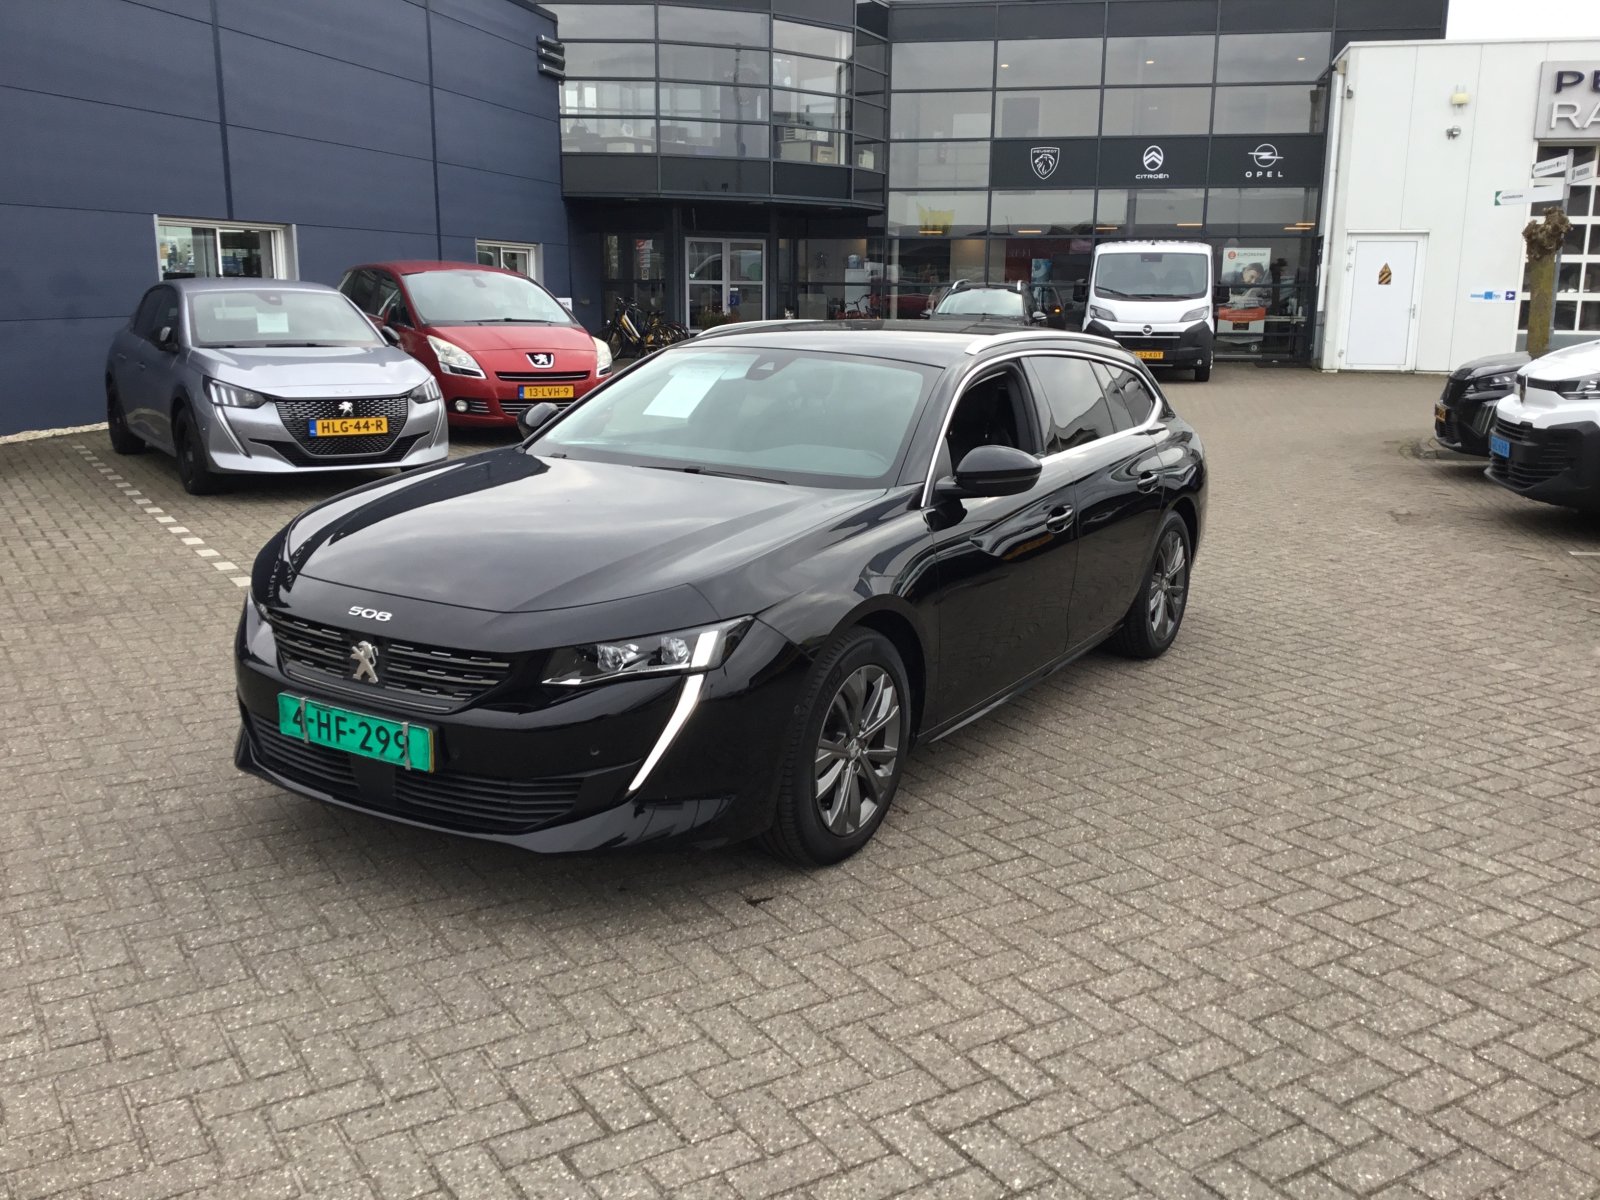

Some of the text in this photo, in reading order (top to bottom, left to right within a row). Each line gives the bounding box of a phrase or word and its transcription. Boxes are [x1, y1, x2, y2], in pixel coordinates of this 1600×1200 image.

[1245, 170, 1283, 178] OPEL
[528, 387, 569, 397] 13-LVH-9
[321, 420, 384, 434] HLG-44-R
[348, 605, 393, 622] 508
